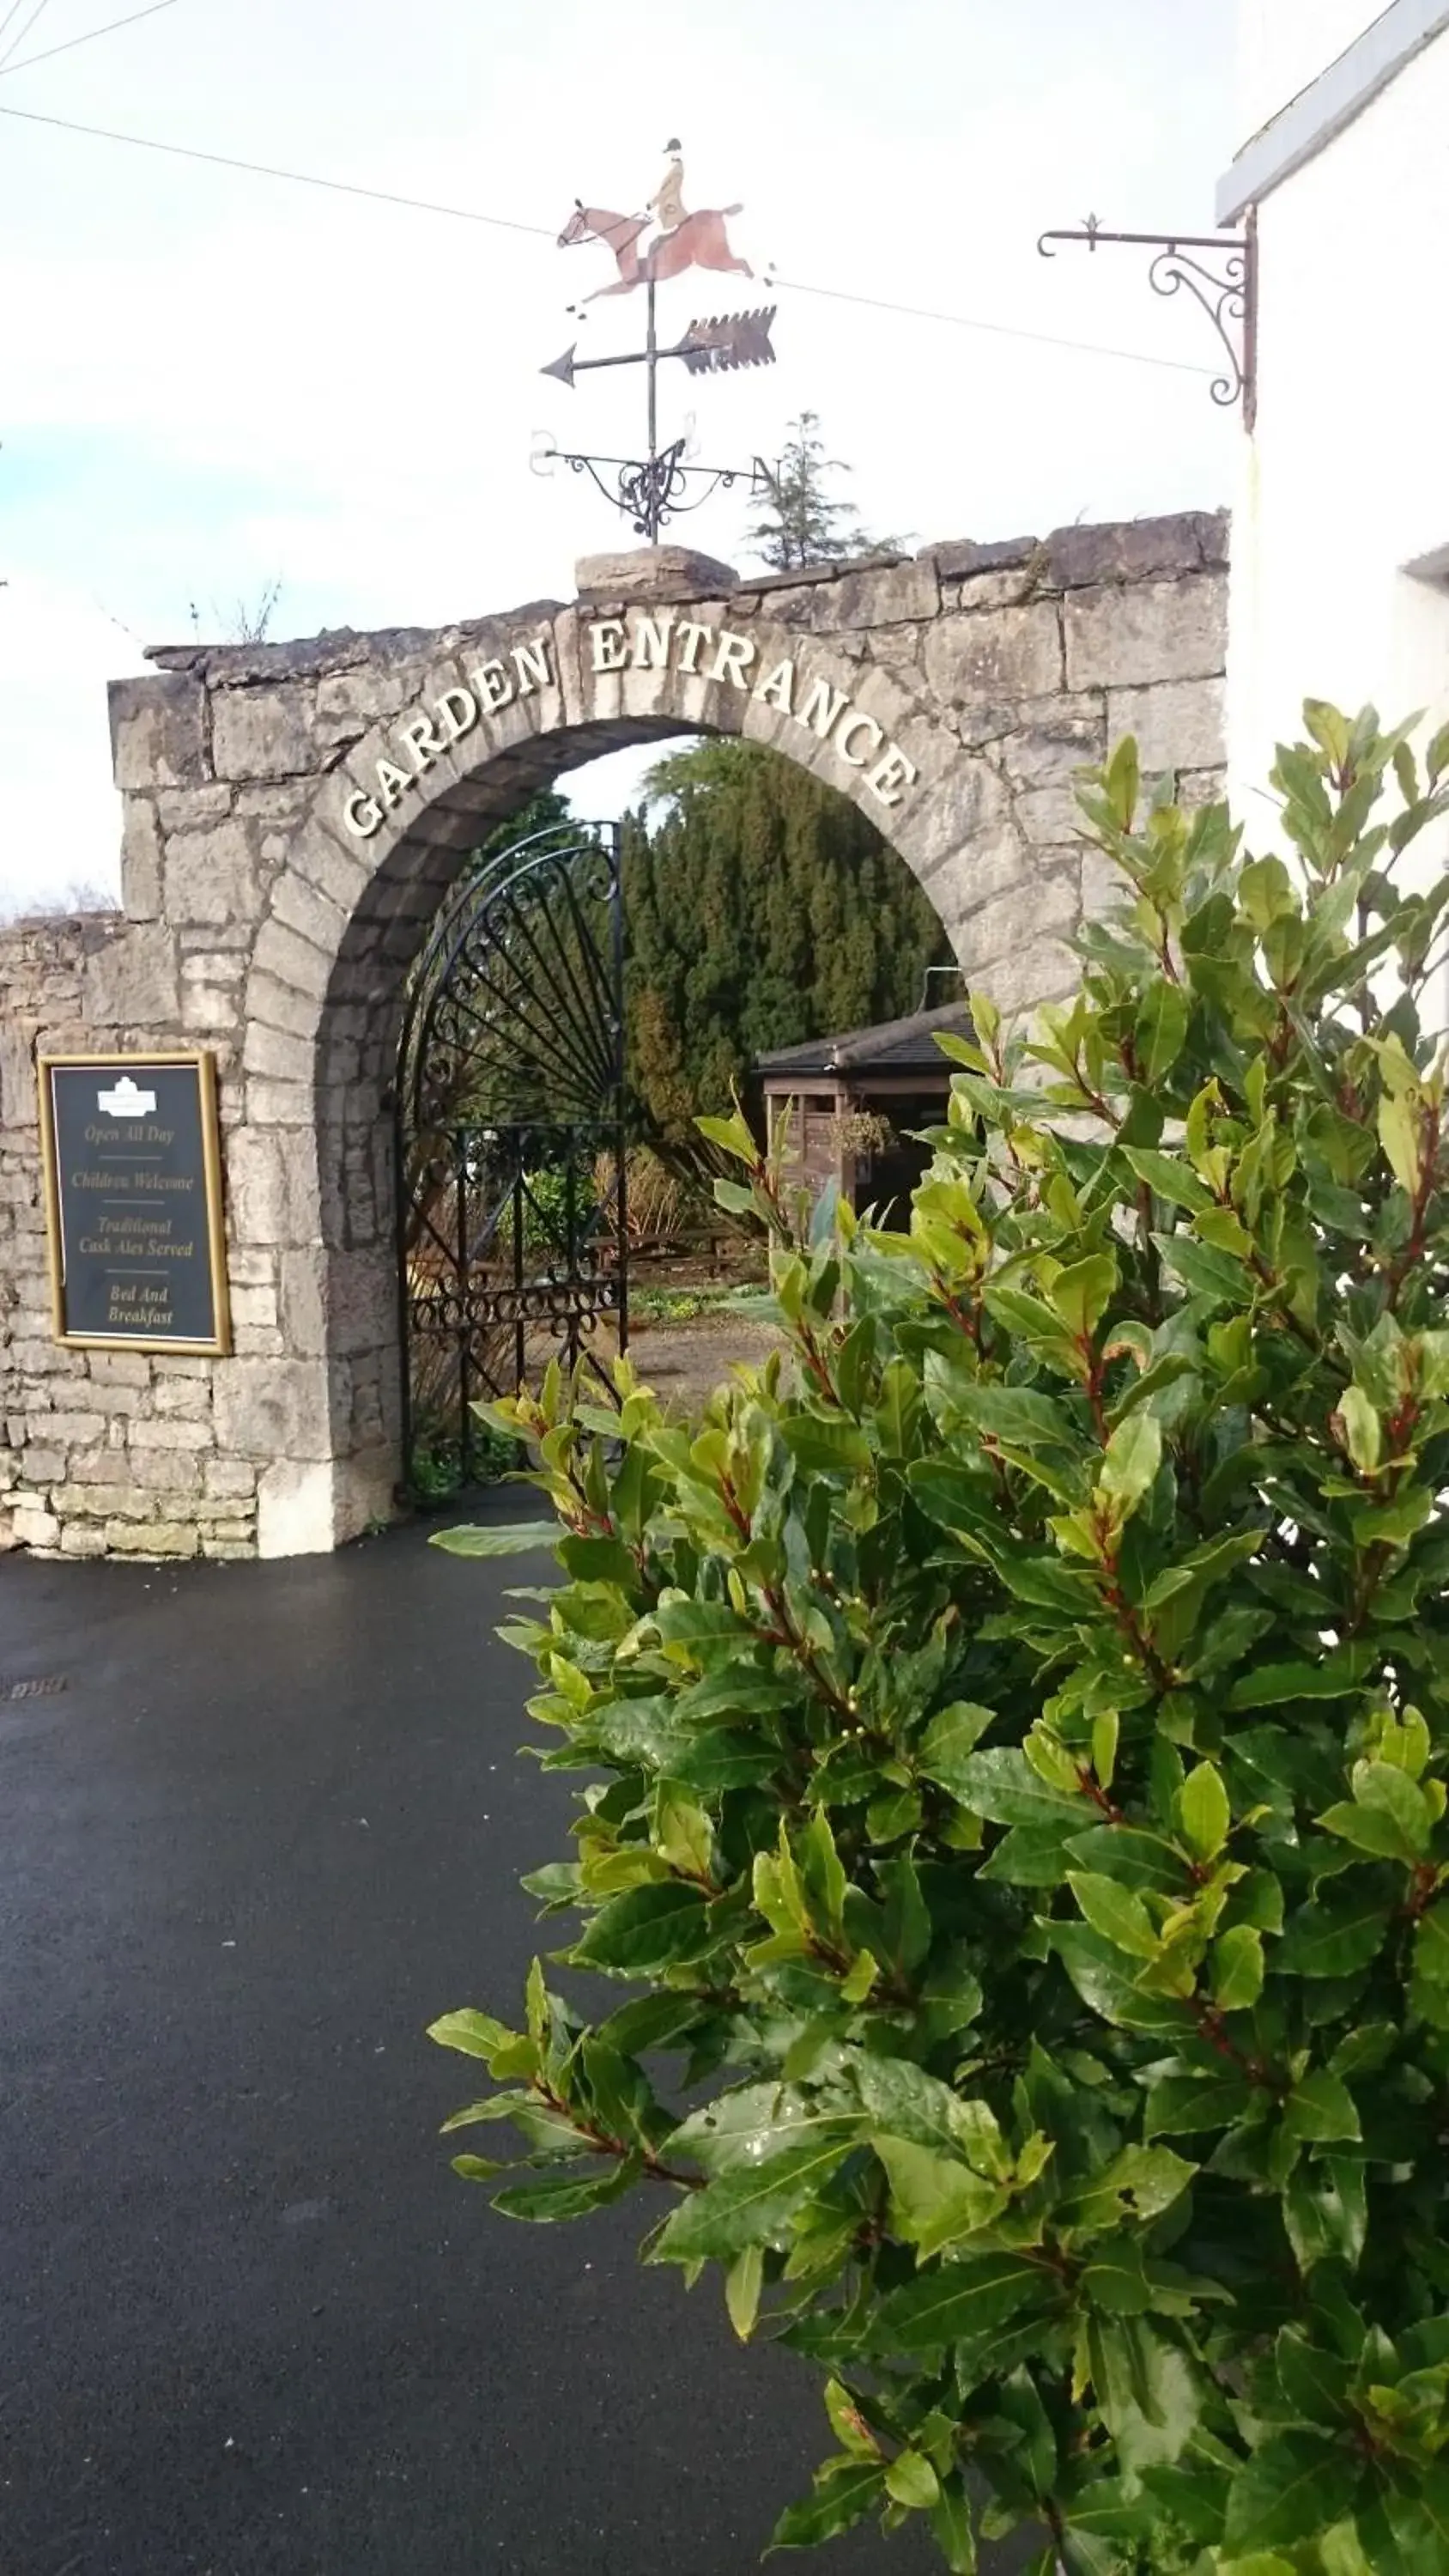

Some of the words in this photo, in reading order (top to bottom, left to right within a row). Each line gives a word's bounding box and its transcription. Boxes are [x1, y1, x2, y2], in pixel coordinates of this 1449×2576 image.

[342, 636, 554, 837] GARDEN
[590, 617, 917, 806] ENTRANCE
[84, 1125, 119, 1145] Open
[127, 1126, 143, 1141] All
[148, 1126, 175, 1146] Day
[71, 1171, 130, 1189] Children
[135, 1172, 194, 1191] Welcome
[98, 1216, 172, 1235] Traditional
[79, 1237, 112, 1254] Cask
[116, 1239, 143, 1255] Ales
[147, 1240, 194, 1257] Served
[110, 1285, 136, 1302] Bed
[138, 1286, 168, 1303] And
[108, 1306, 173, 1327] Breakfast
